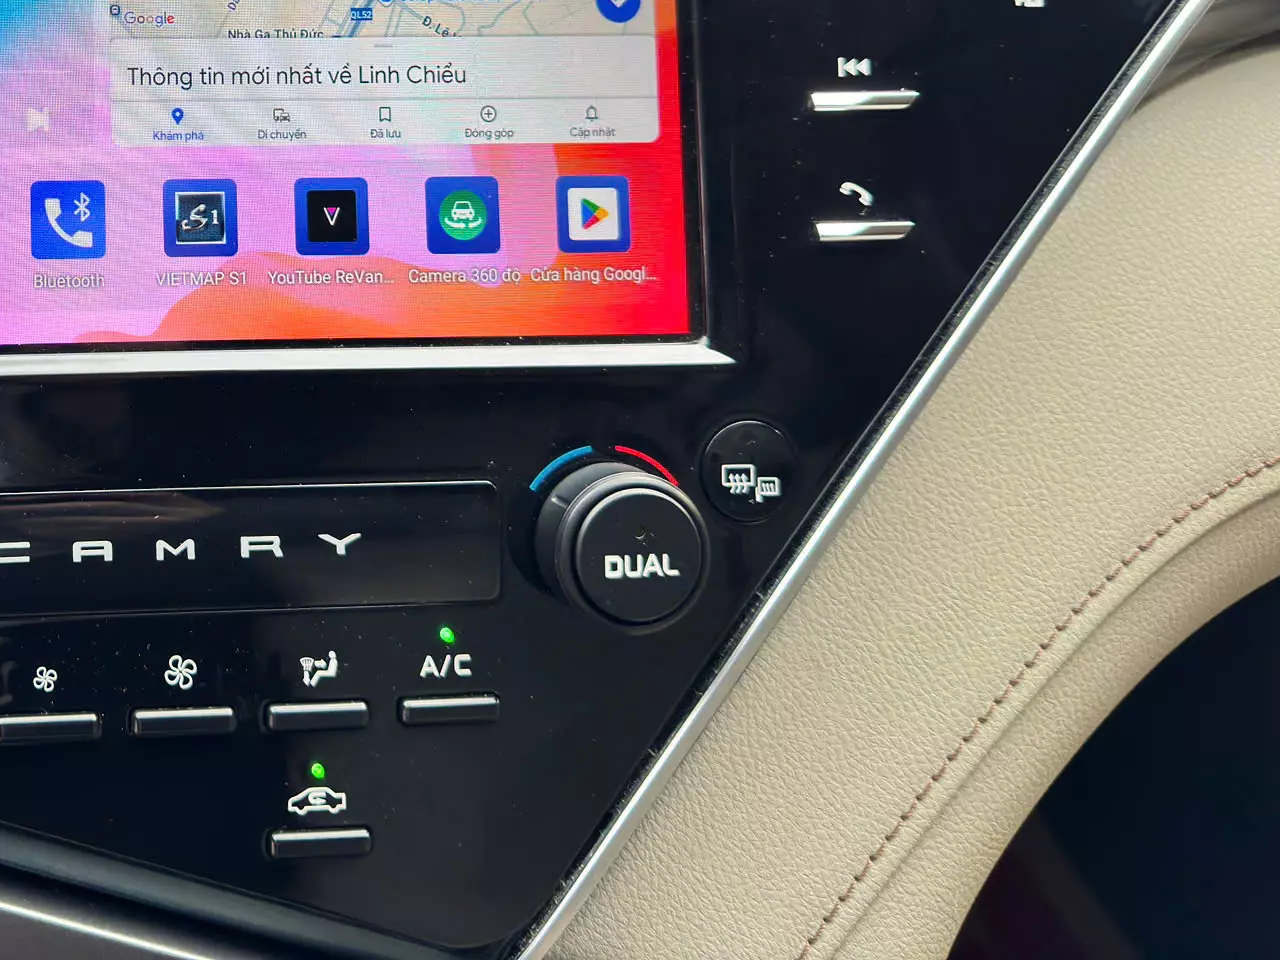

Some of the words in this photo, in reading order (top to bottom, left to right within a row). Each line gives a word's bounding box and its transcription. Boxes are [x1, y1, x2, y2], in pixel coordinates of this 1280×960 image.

[124, 11, 175, 27] Google
[351, 10, 372, 20] QL52
[128, 66, 193, 90] Thông
[199, 67, 225, 85] tin
[231, 66, 270, 85] mới
[276, 63, 322, 85] nhất
[327, 63, 352, 84] về
[358, 65, 400, 84] Linh
[406, 63, 466, 84] Chiểu
[33, 273, 105, 289] Bluetooth
[156, 271, 224, 286] VIETMAP
[229, 271, 247, 285] S1
[267, 271, 331, 284] YouTube
[408, 268, 466, 283] Camera
[470, 268, 498, 282] 360
[502, 267, 520, 284] độ
[564, 266, 600, 284] hàng
[604, 554, 680, 580] DUAL
[420, 655, 472, 680] A/C
